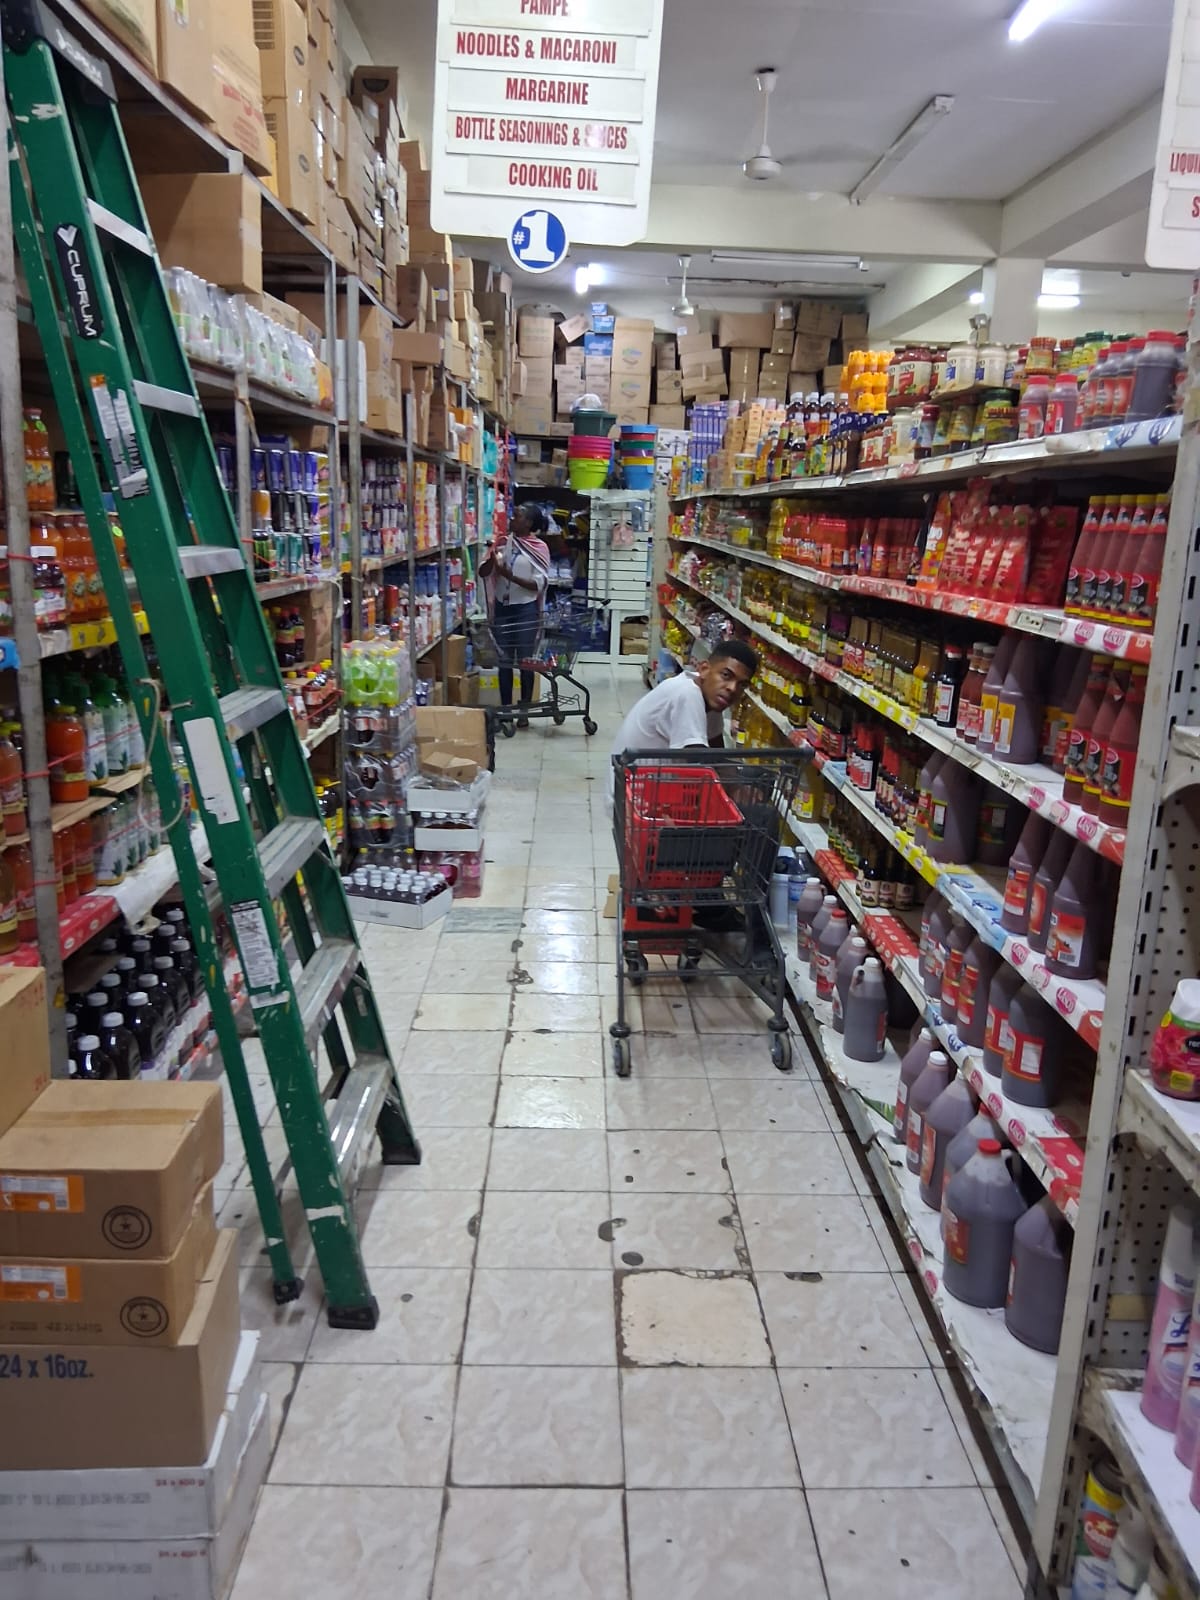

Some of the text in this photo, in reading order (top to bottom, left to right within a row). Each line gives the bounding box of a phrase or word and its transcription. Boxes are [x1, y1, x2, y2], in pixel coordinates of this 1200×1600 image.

[456, 32, 617, 64] NOODLES & MACARONI
[505, 77, 589, 105] MARGARINE
[455, 116, 628, 149] BOTTLE SEASONINGS & SCES
[508, 162, 598, 191] COOKING OIL
[1169, 152, 1200, 175] LIQUI
[67, 249, 98, 337] CUPRUM
[0, 1354, 95, 1379] 24 x 16oz.
